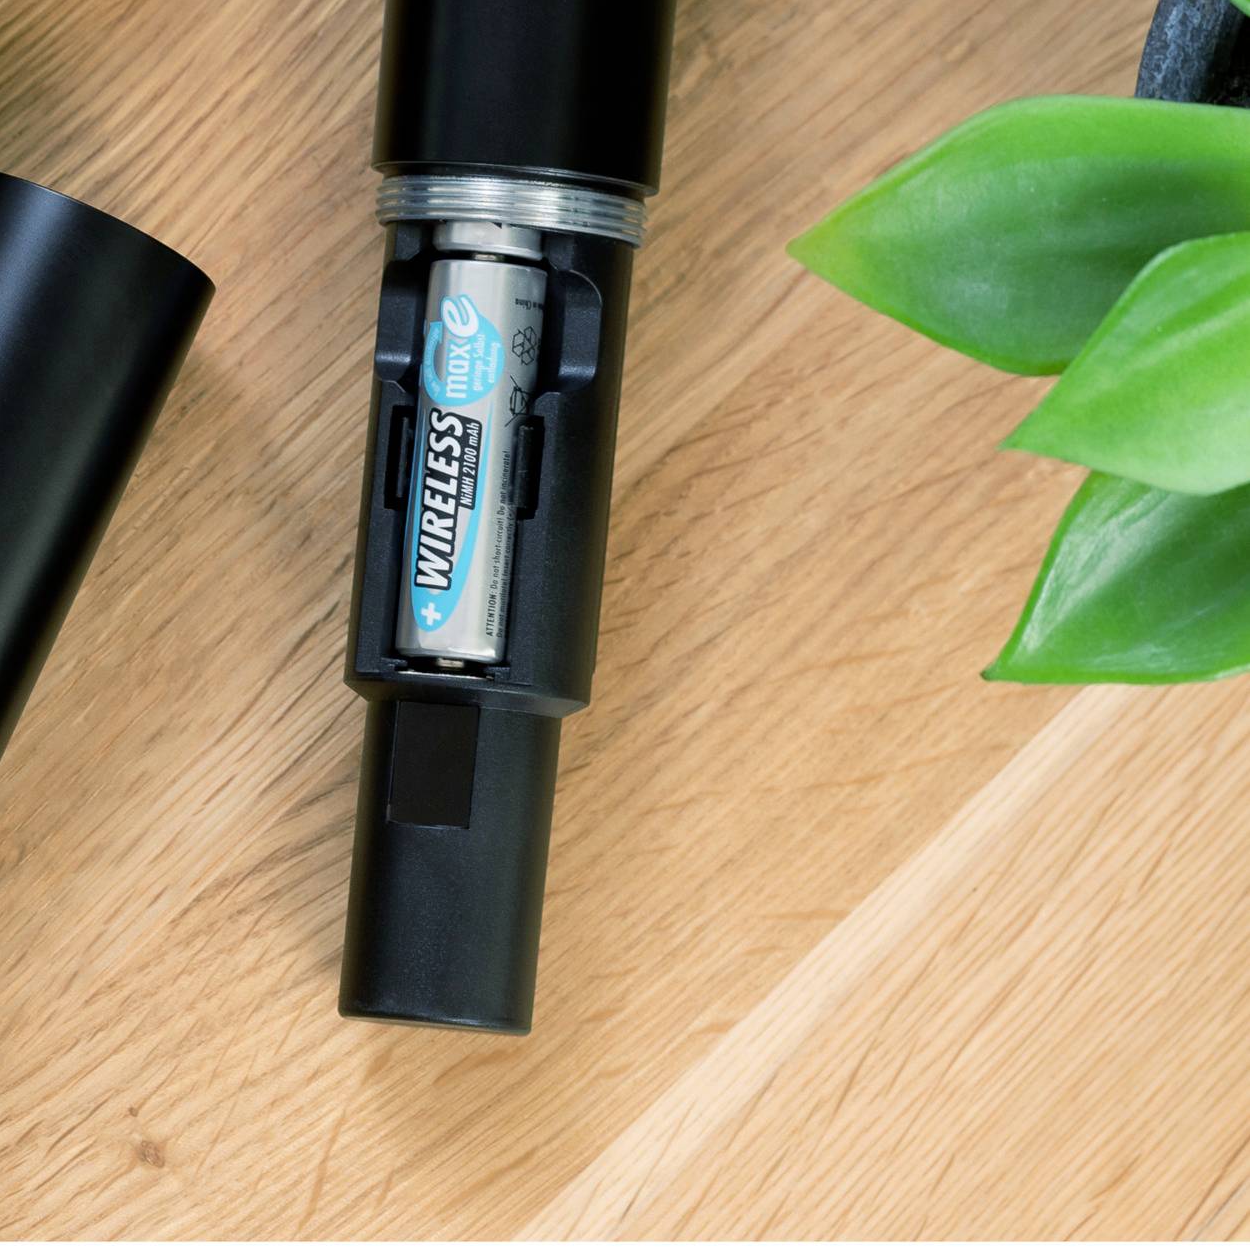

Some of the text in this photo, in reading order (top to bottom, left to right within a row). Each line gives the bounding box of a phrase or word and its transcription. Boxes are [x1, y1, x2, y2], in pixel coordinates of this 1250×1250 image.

[458, 421, 480, 505] NiMH 2100 mAh
[415, 411, 466, 588] WIRELESS
[497, 490, 507, 504] not
[496, 505, 505, 515] Do
[490, 564, 500, 577] not
[489, 579, 498, 589] Do
